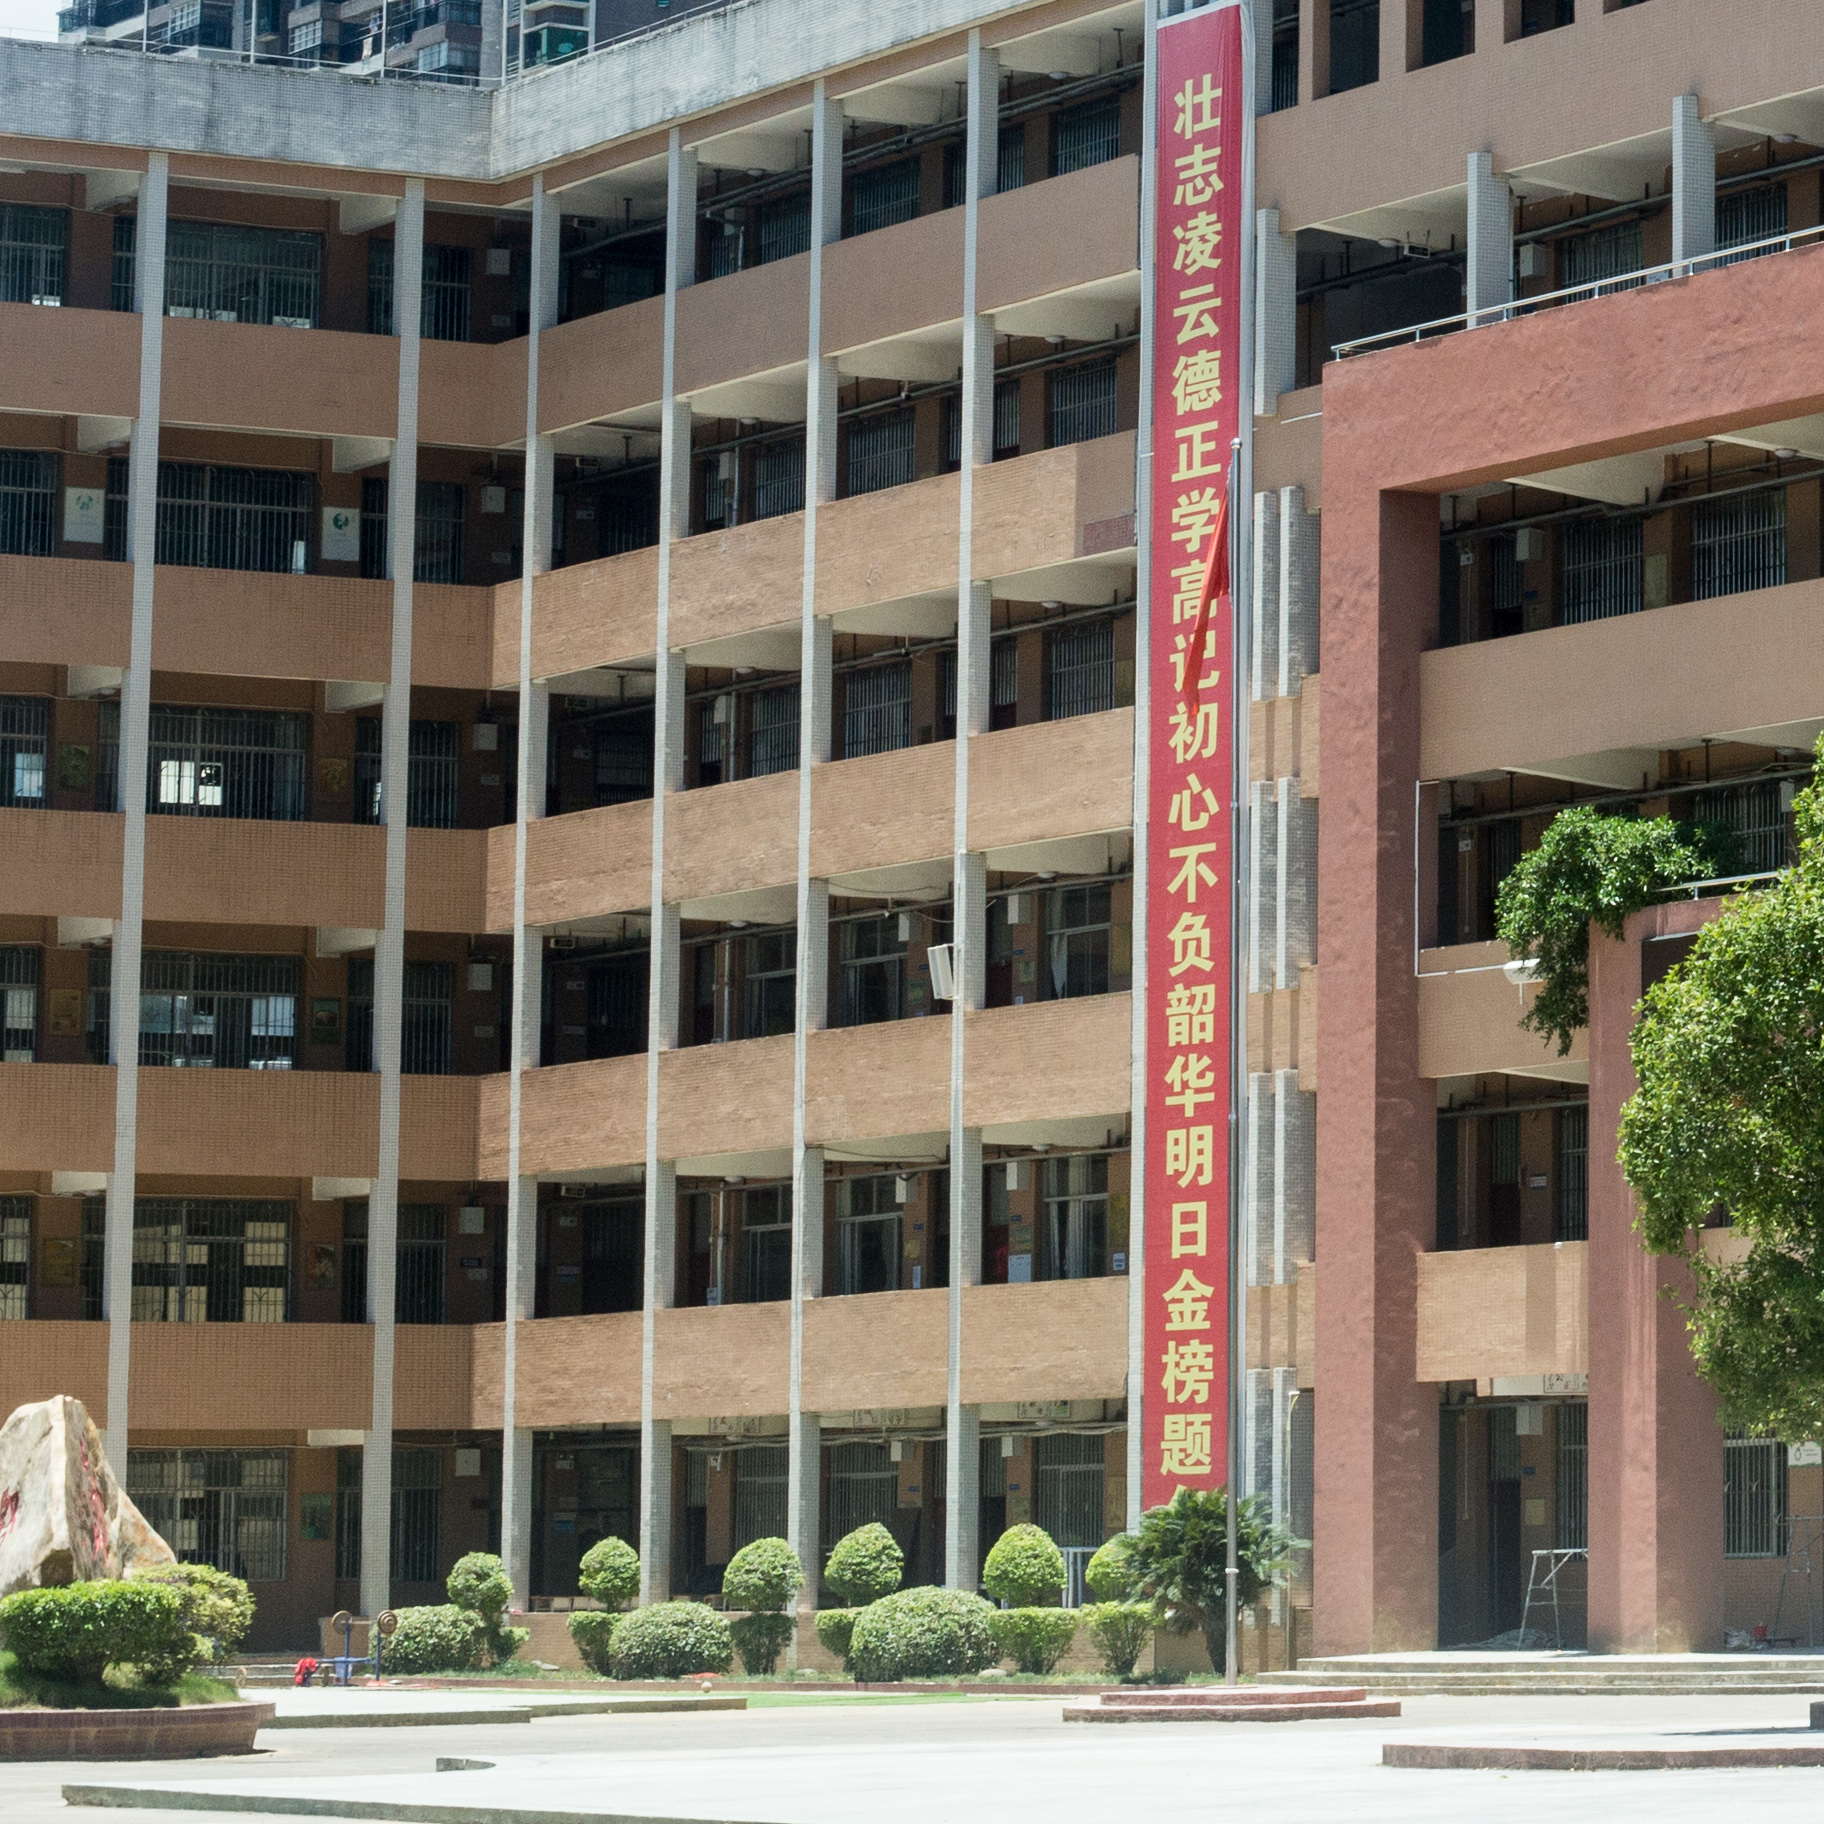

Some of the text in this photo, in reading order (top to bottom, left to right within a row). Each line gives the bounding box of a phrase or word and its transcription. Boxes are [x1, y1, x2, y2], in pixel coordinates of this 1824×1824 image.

[1160, 72, 1223, 1507] 壮志凌云德正学高记初心不负韶华明日金榜题
